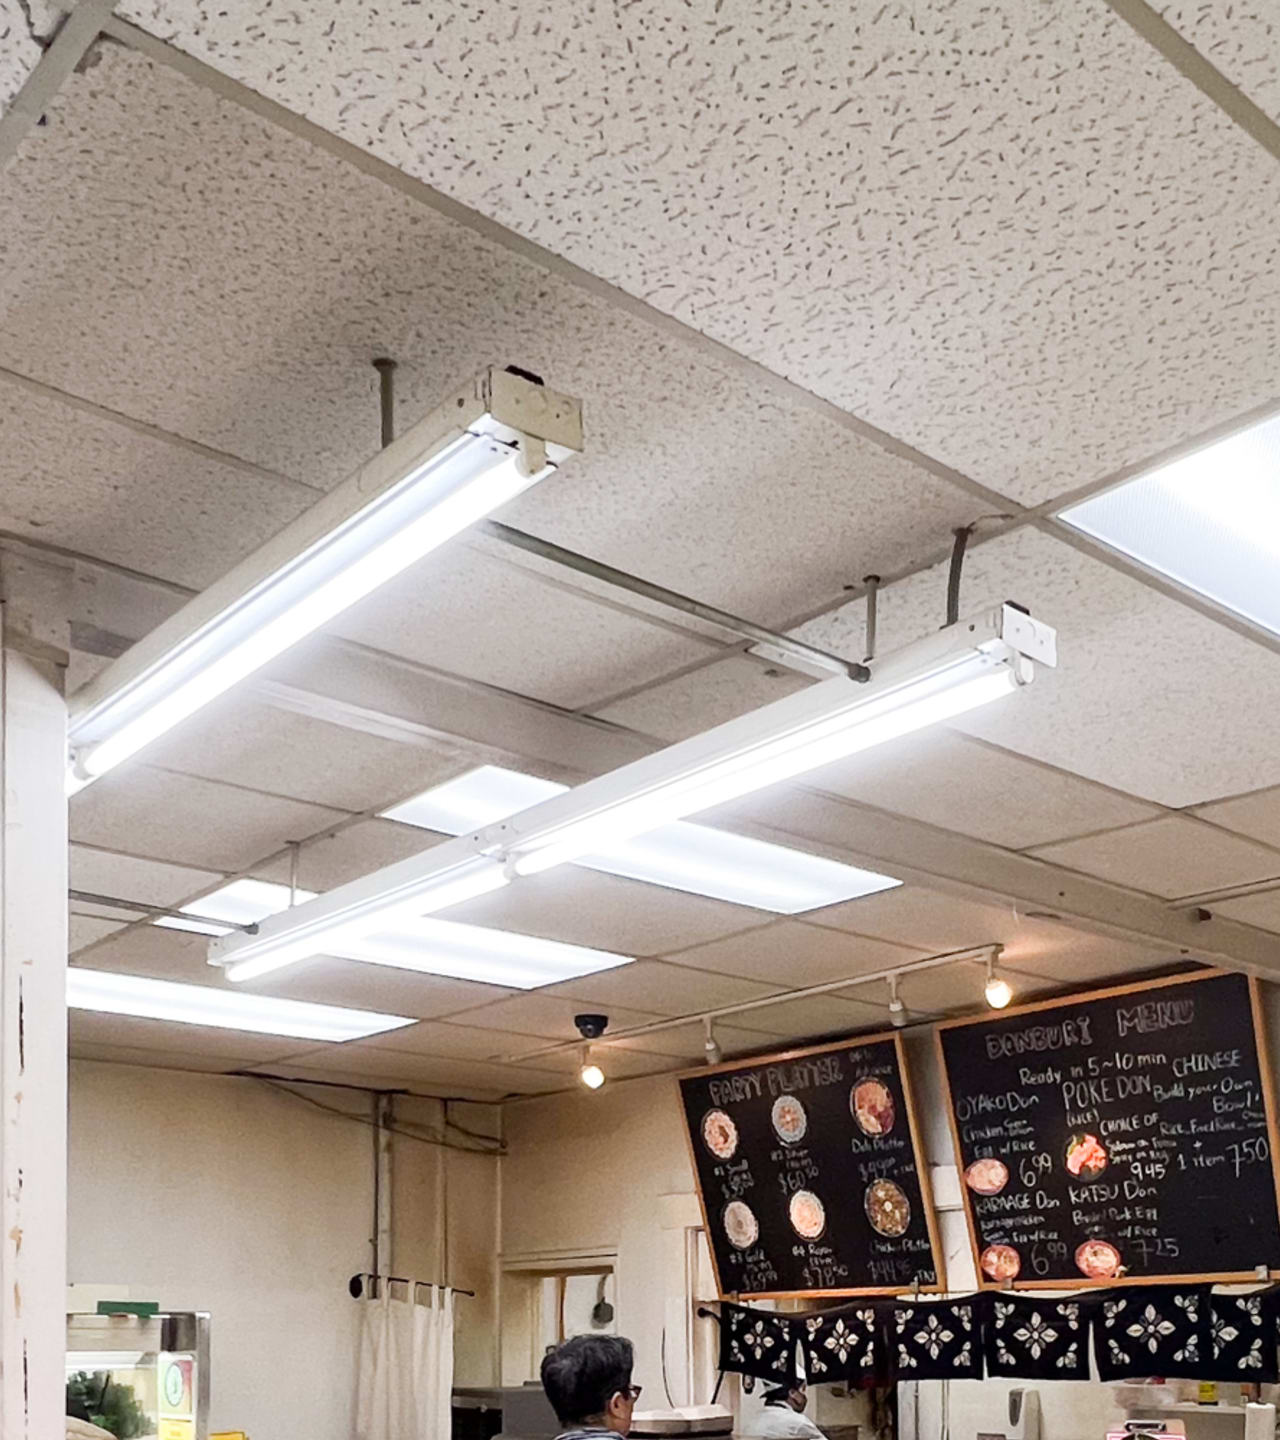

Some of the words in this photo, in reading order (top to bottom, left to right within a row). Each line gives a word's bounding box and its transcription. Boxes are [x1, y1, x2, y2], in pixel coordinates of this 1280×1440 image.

[1116, 1000, 1195, 1037] MENU
[1019, 1067, 1062, 1087] Ready
[1071, 1065, 1083, 1078] in
[1137, 1053, 1167, 1067] min
[1172, 1050, 1242, 1078] CHINESE
[1062, 1078, 1112, 1111] POKE
[1117, 1075, 1152, 1100] DON
[1144, 1112, 1159, 1126] OF
[1069, 1182, 1119, 1203] KATSU
[1123, 1180, 1157, 1200] Don
